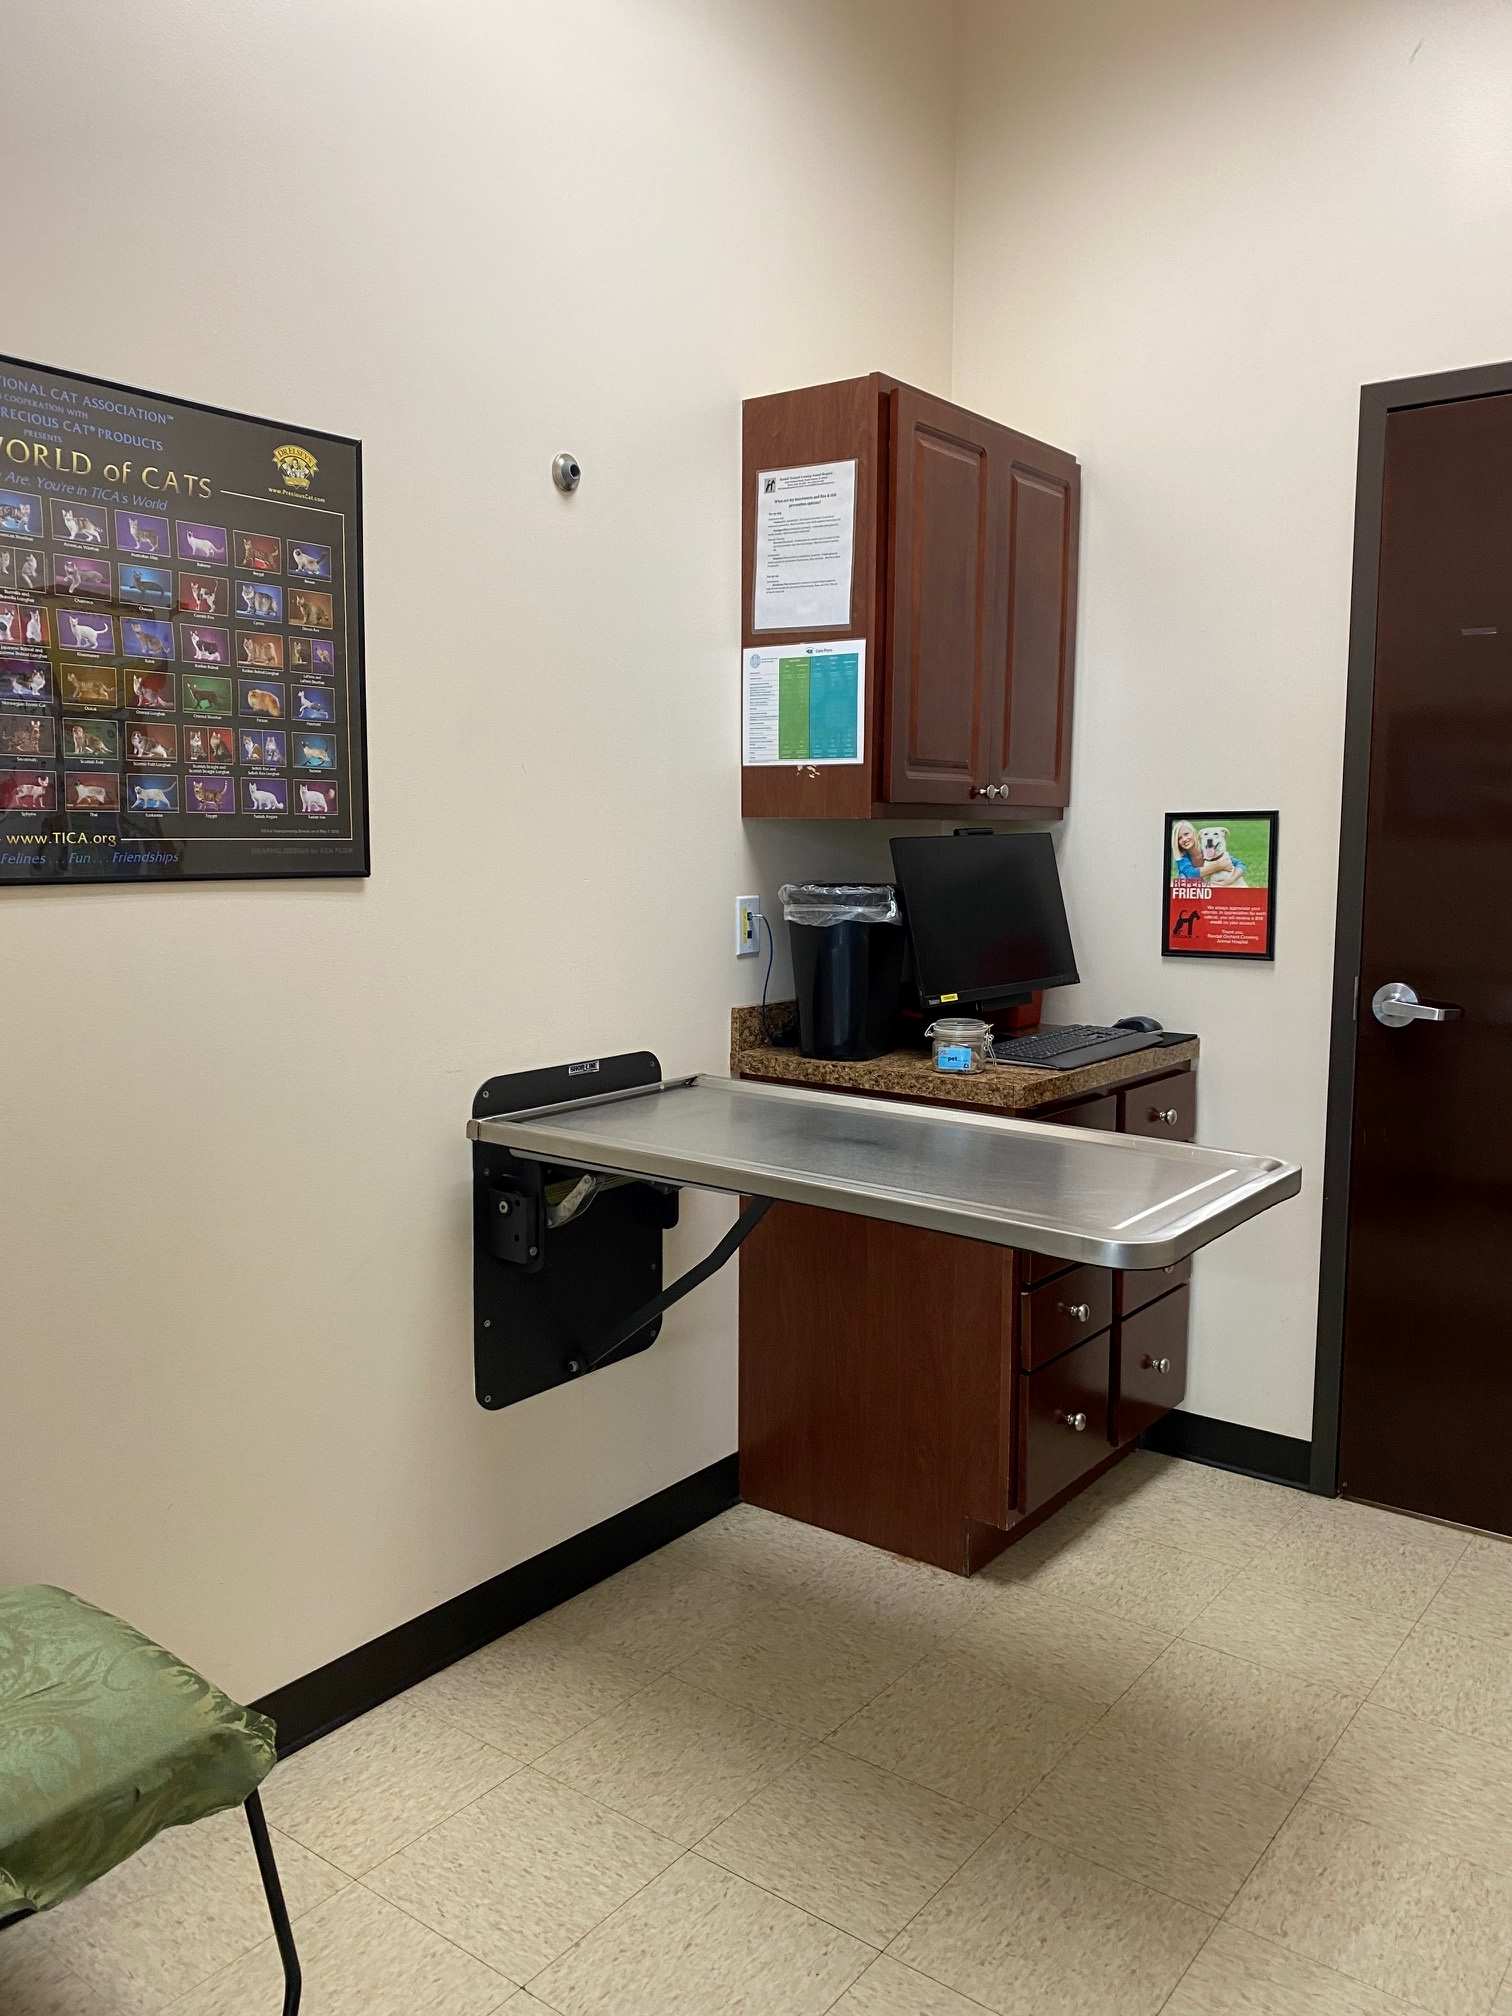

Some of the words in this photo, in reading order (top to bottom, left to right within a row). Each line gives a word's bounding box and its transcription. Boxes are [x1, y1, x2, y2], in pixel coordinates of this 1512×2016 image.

[0, 375, 46, 397] IONAL
[50, 388, 79, 403] CAT
[66, 408, 88, 420] WITH
[0, 406, 59, 429] RECIOUS
[97, 427, 164, 451] PRODUCTS
[103, 460, 132, 484] of
[141, 466, 213, 499] CATS
[77, 486, 88, 497] in
[91, 486, 128, 504] TICA's
[132, 495, 169, 511] World
[6, 832, 117, 847] www.TICA.org
[0, 853, 46, 865] Felines
[68, 853, 92, 864] Fun
[112, 851, 178, 865] Friendships
[1172, 887, 1213, 900] FRIEND
